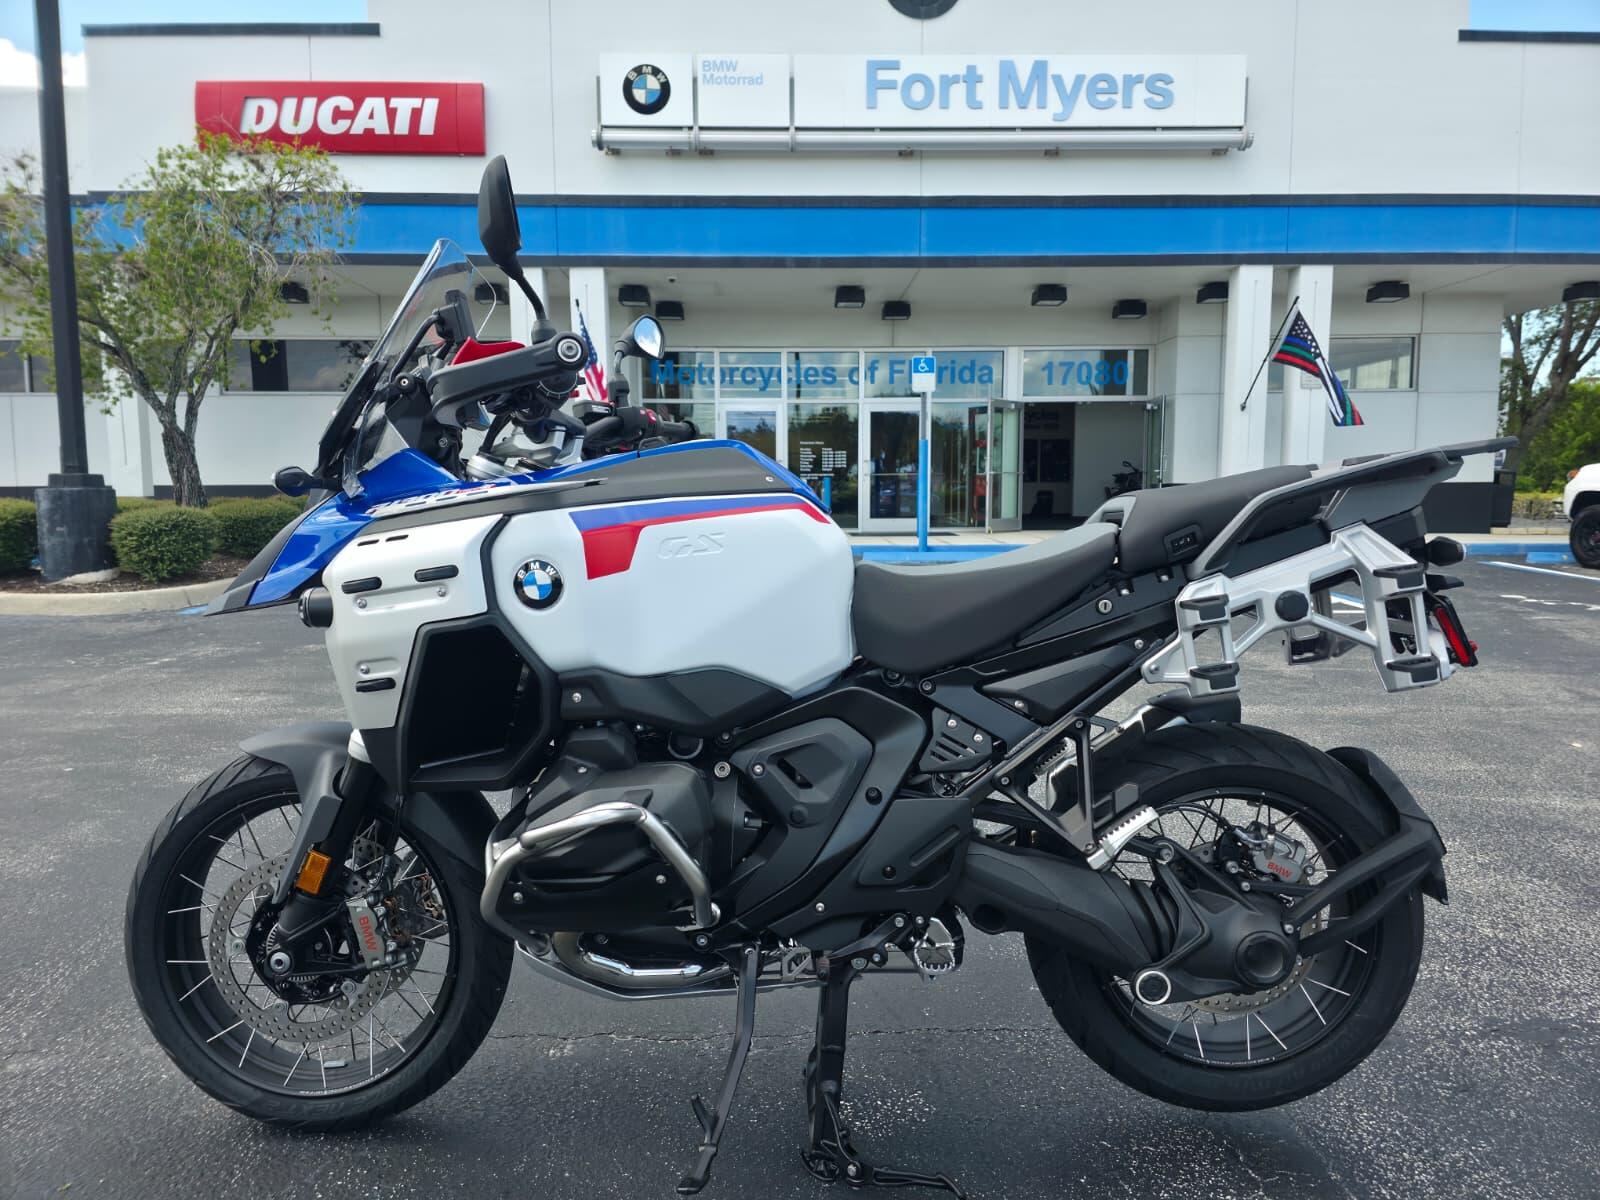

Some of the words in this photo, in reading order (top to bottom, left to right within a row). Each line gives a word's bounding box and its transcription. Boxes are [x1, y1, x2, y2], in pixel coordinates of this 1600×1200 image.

[627, 65, 668, 83] BMW
[702, 60, 739, 72] BMW
[702, 72, 764, 86] Motorrad
[865, 59, 984, 110] Fort
[998, 59, 1175, 122] Myers
[240, 96, 440, 135] DUCATI
[650, 359, 838, 391] Motorcycles
[848, 360, 880, 385] of
[888, 360, 994, 385] Flrida
[1042, 360, 1129, 385] 17080
[517, 561, 557, 579] BMW
[1266, 862, 1293, 879] BMW
[359, 915, 378, 951] BMW
